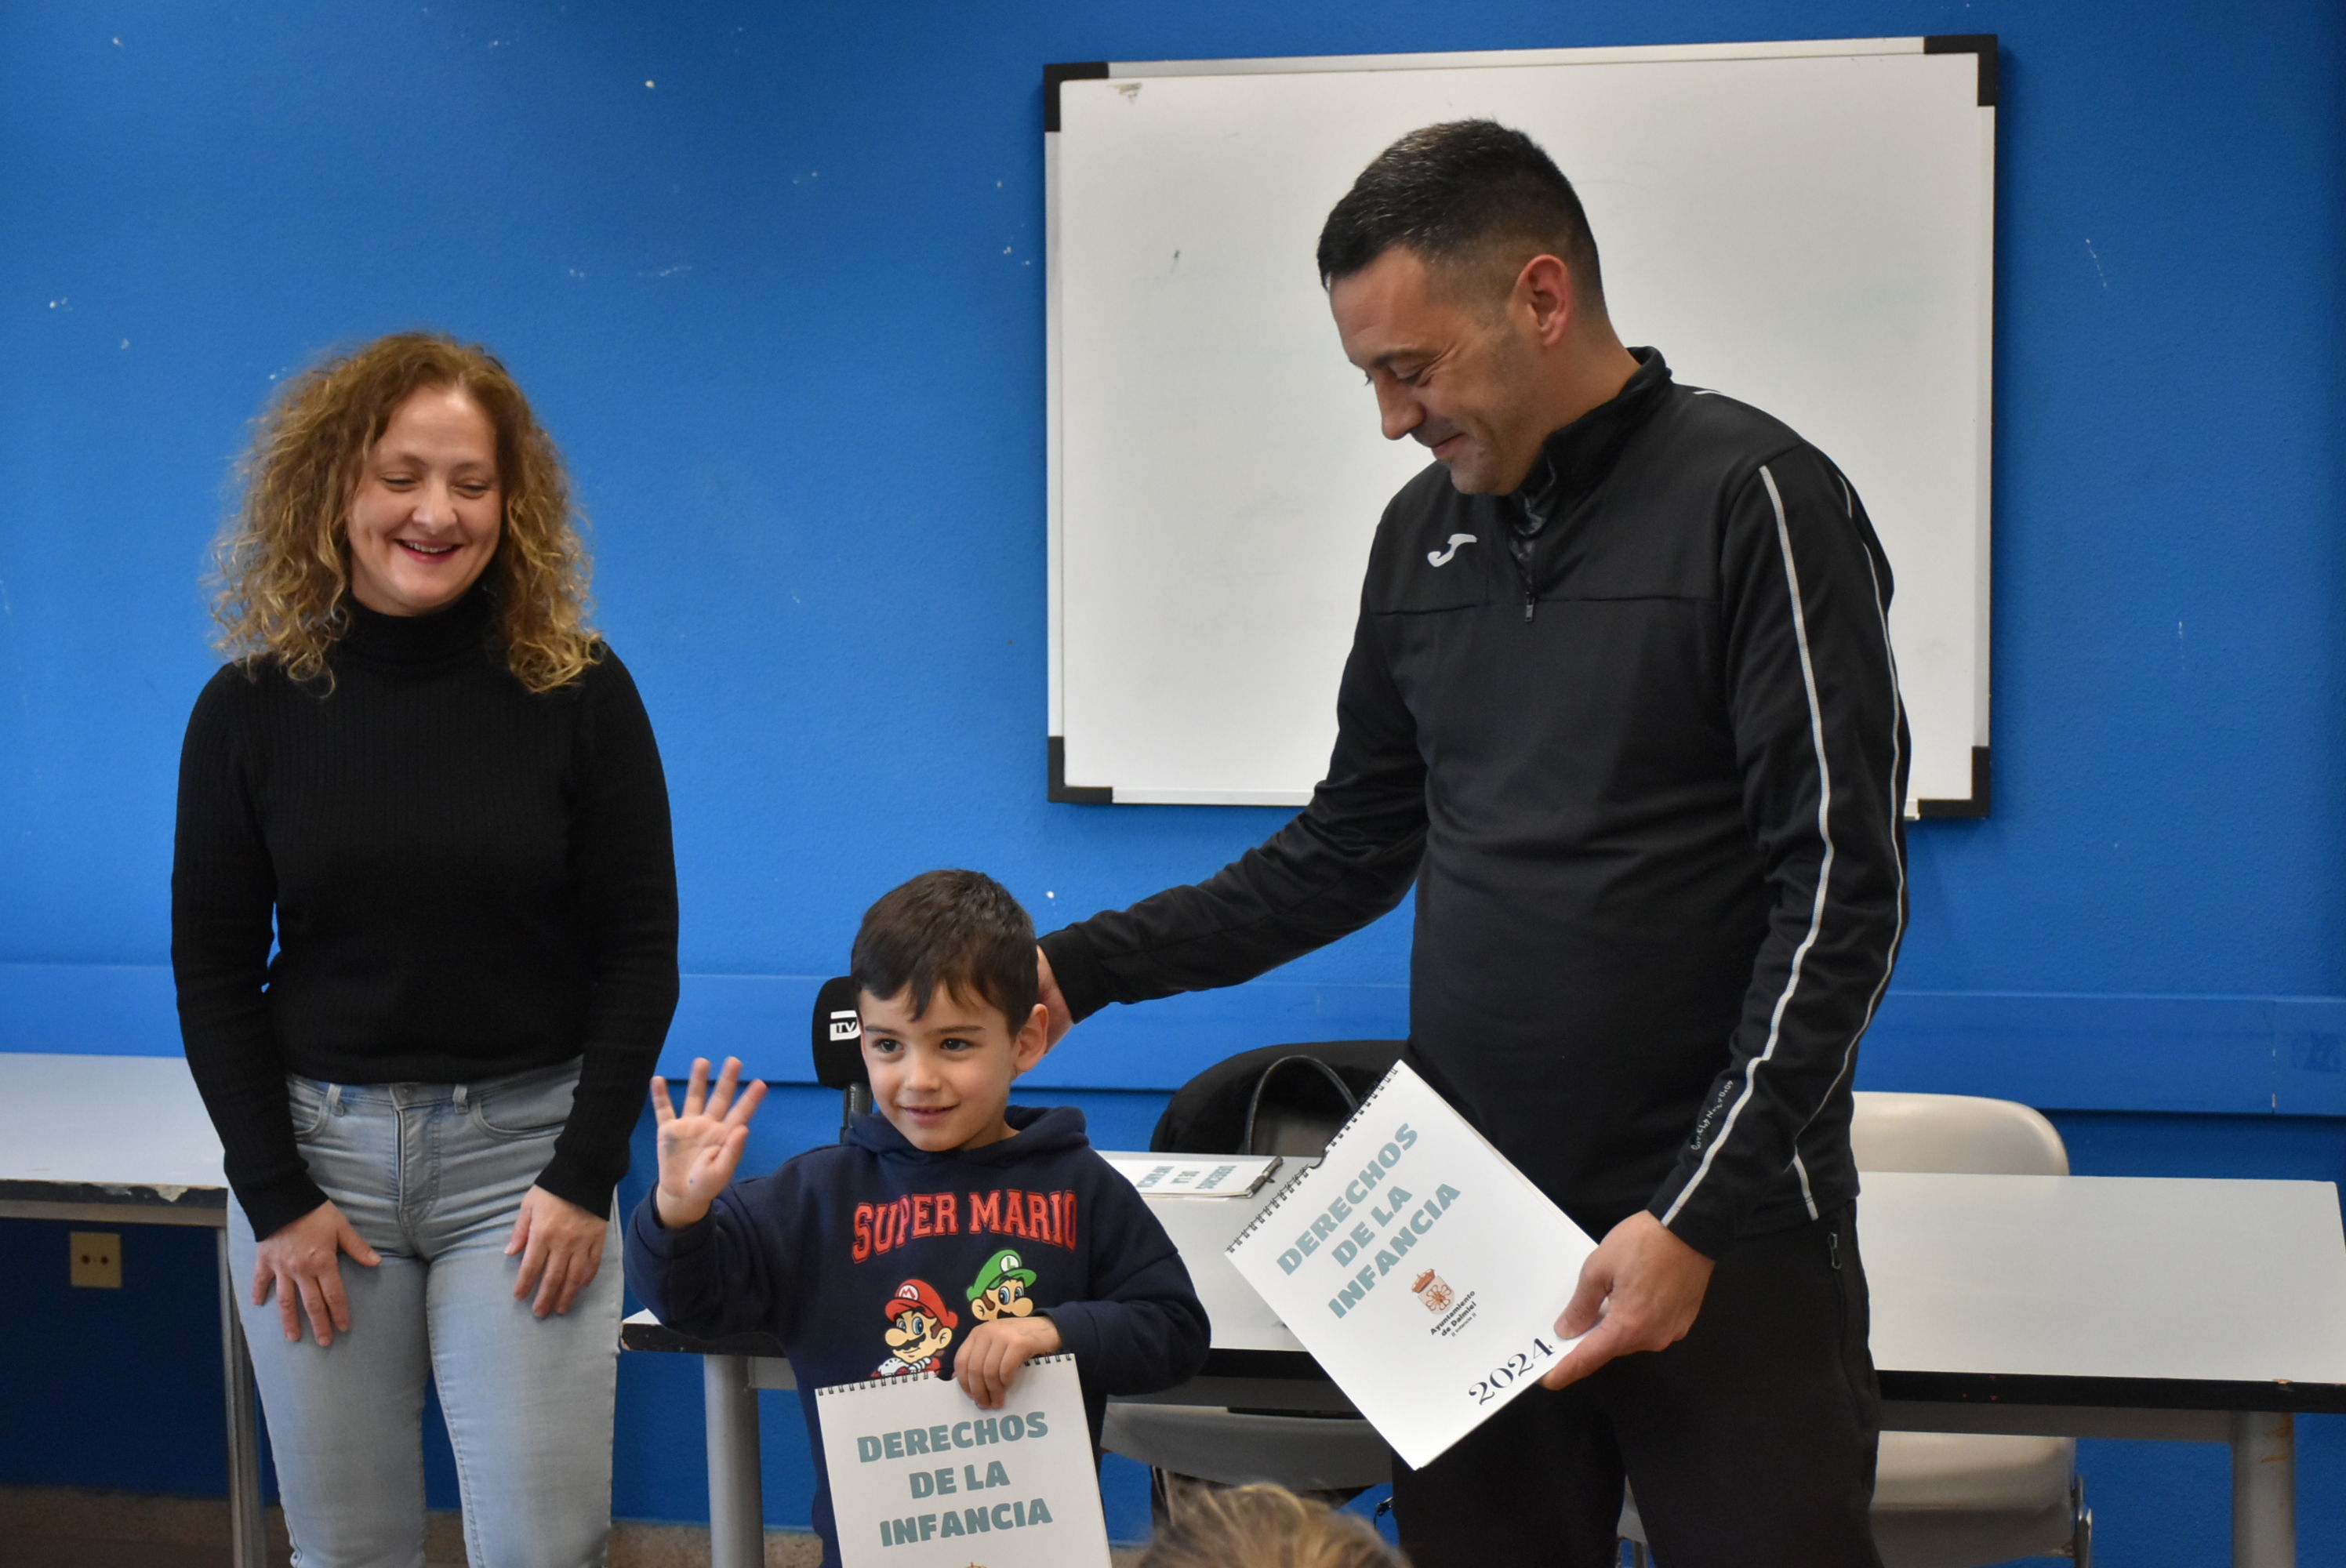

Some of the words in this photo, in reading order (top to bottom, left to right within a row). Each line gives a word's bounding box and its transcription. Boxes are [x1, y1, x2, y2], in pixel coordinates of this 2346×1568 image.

[852, 1191, 961, 1264] SUPER
[969, 1189, 1078, 1251] MARIO
[1276, 1123, 1418, 1276] DERECHOS
[1331, 1221, 1375, 1268] DE
[1371, 1185, 1414, 1228] LA
[1328, 1183, 1461, 1319] INFANCIA
[1430, 1290, 1476, 1335] Ayuntamiento
[1441, 1327, 1451, 1336] de
[1451, 1301, 1476, 1327] Daimiel
[1469, 1338, 1556, 1406] 2024
[857, 1411, 1049, 1464] DERECHOS
[910, 1468, 957, 1499] DE
[964, 1461, 1011, 1490] LA
[880, 1498, 1053, 1547] INFANCIA
